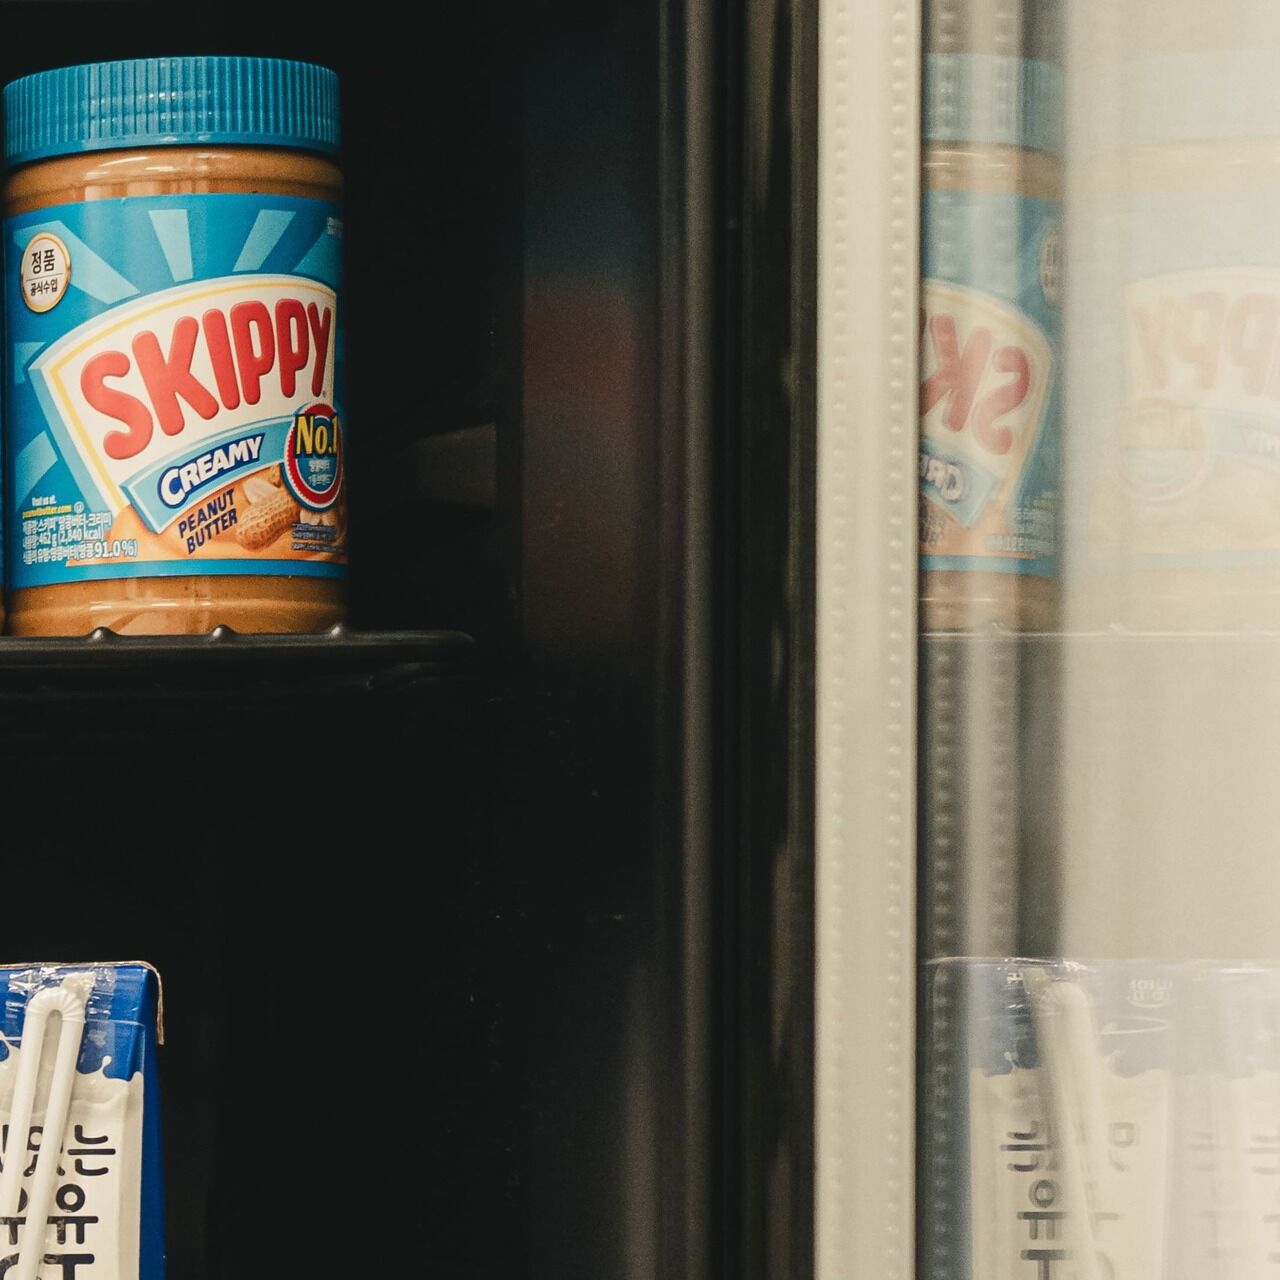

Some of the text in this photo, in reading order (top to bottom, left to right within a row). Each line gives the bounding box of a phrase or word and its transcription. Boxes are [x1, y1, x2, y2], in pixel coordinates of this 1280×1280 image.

[32, 249, 55, 274] 정품
[30, 278, 58, 296] 공식수입
[79, 299, 333, 460] SKIPPY
[296, 415, 338, 455] No.1
[159, 434, 264, 508] CREAMY
[178, 488, 234, 538] PEANUT
[186, 508, 237, 554] BUTTER
